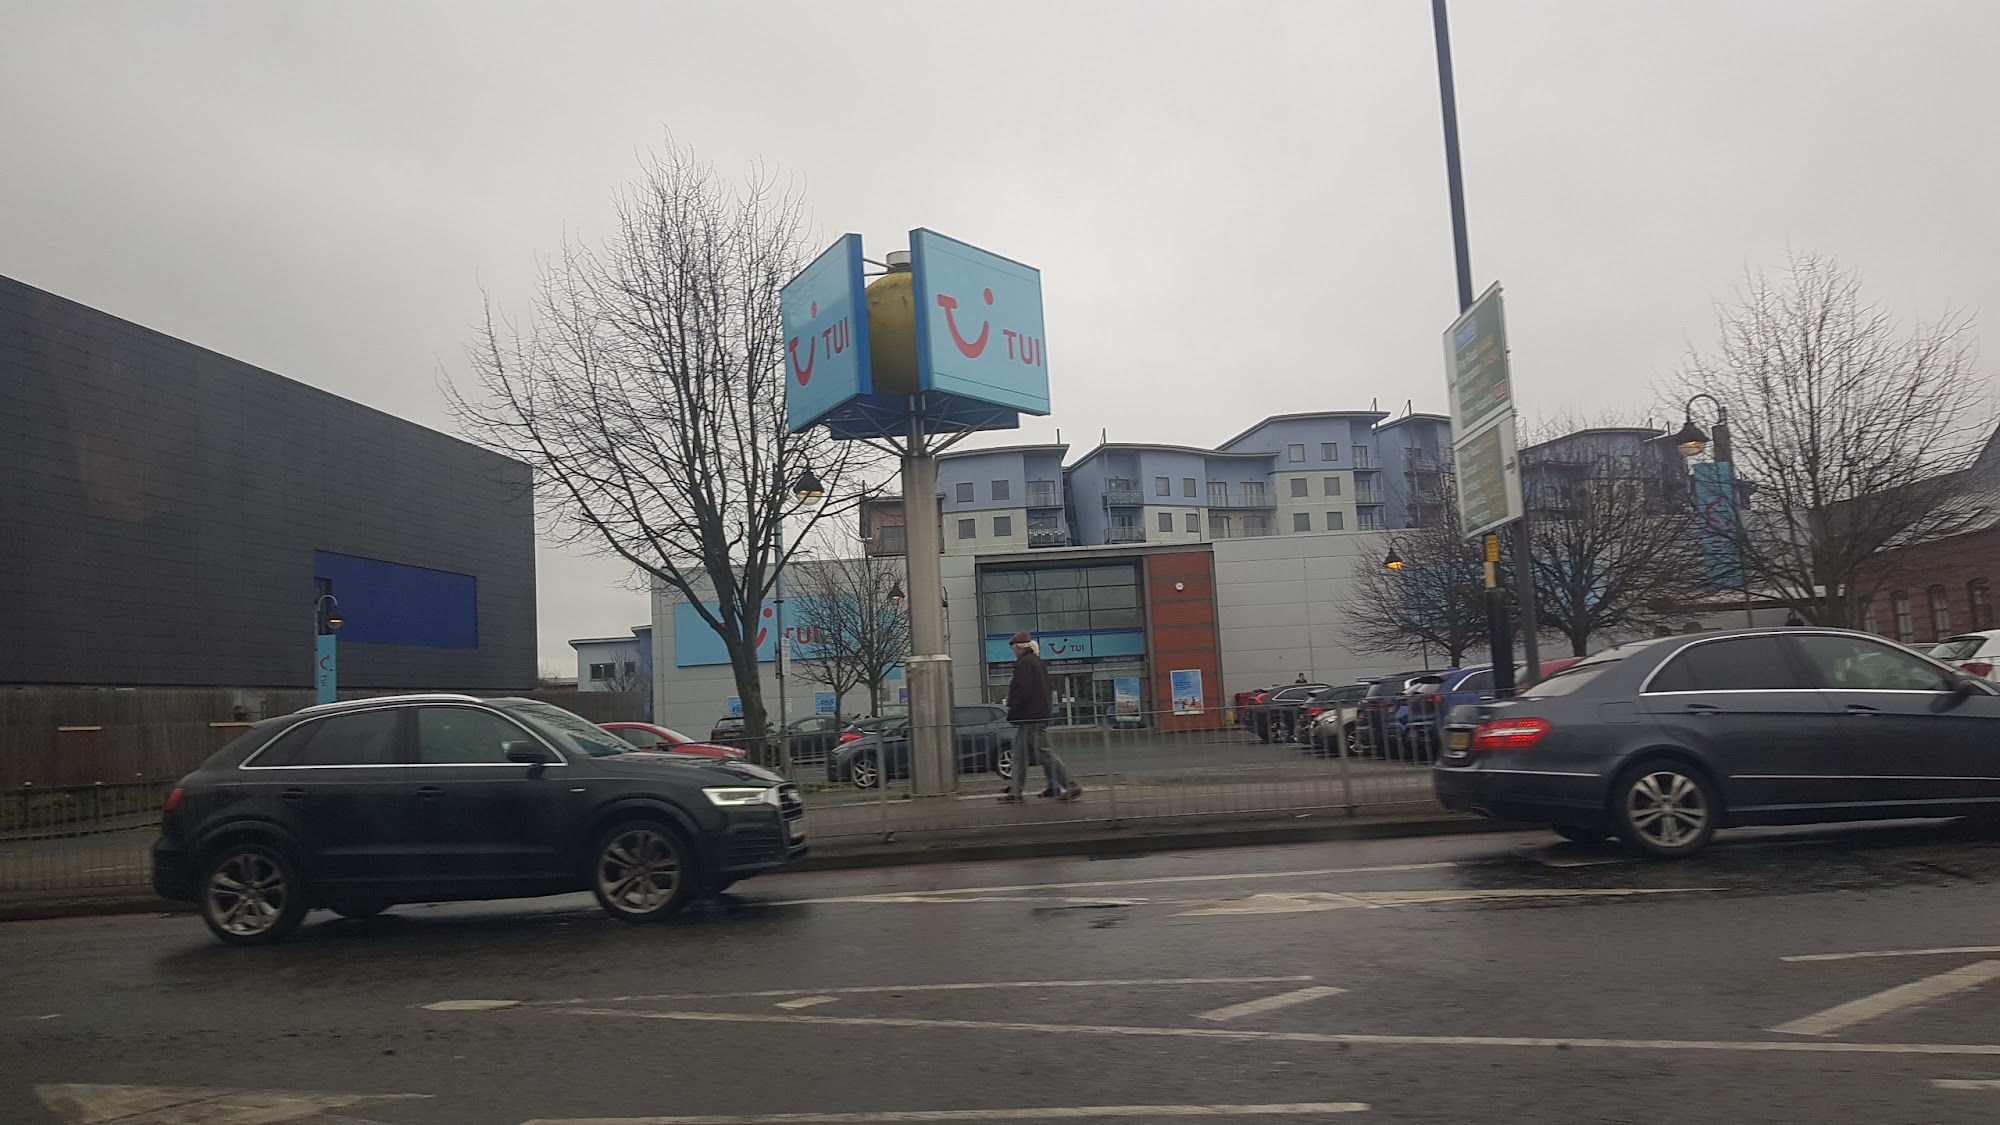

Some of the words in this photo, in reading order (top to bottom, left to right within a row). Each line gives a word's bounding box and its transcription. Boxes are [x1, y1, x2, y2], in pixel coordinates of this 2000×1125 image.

[822, 316, 851, 360] TUI
[1002, 328, 1042, 368] TUI
[1070, 644, 1085, 652] TUI
